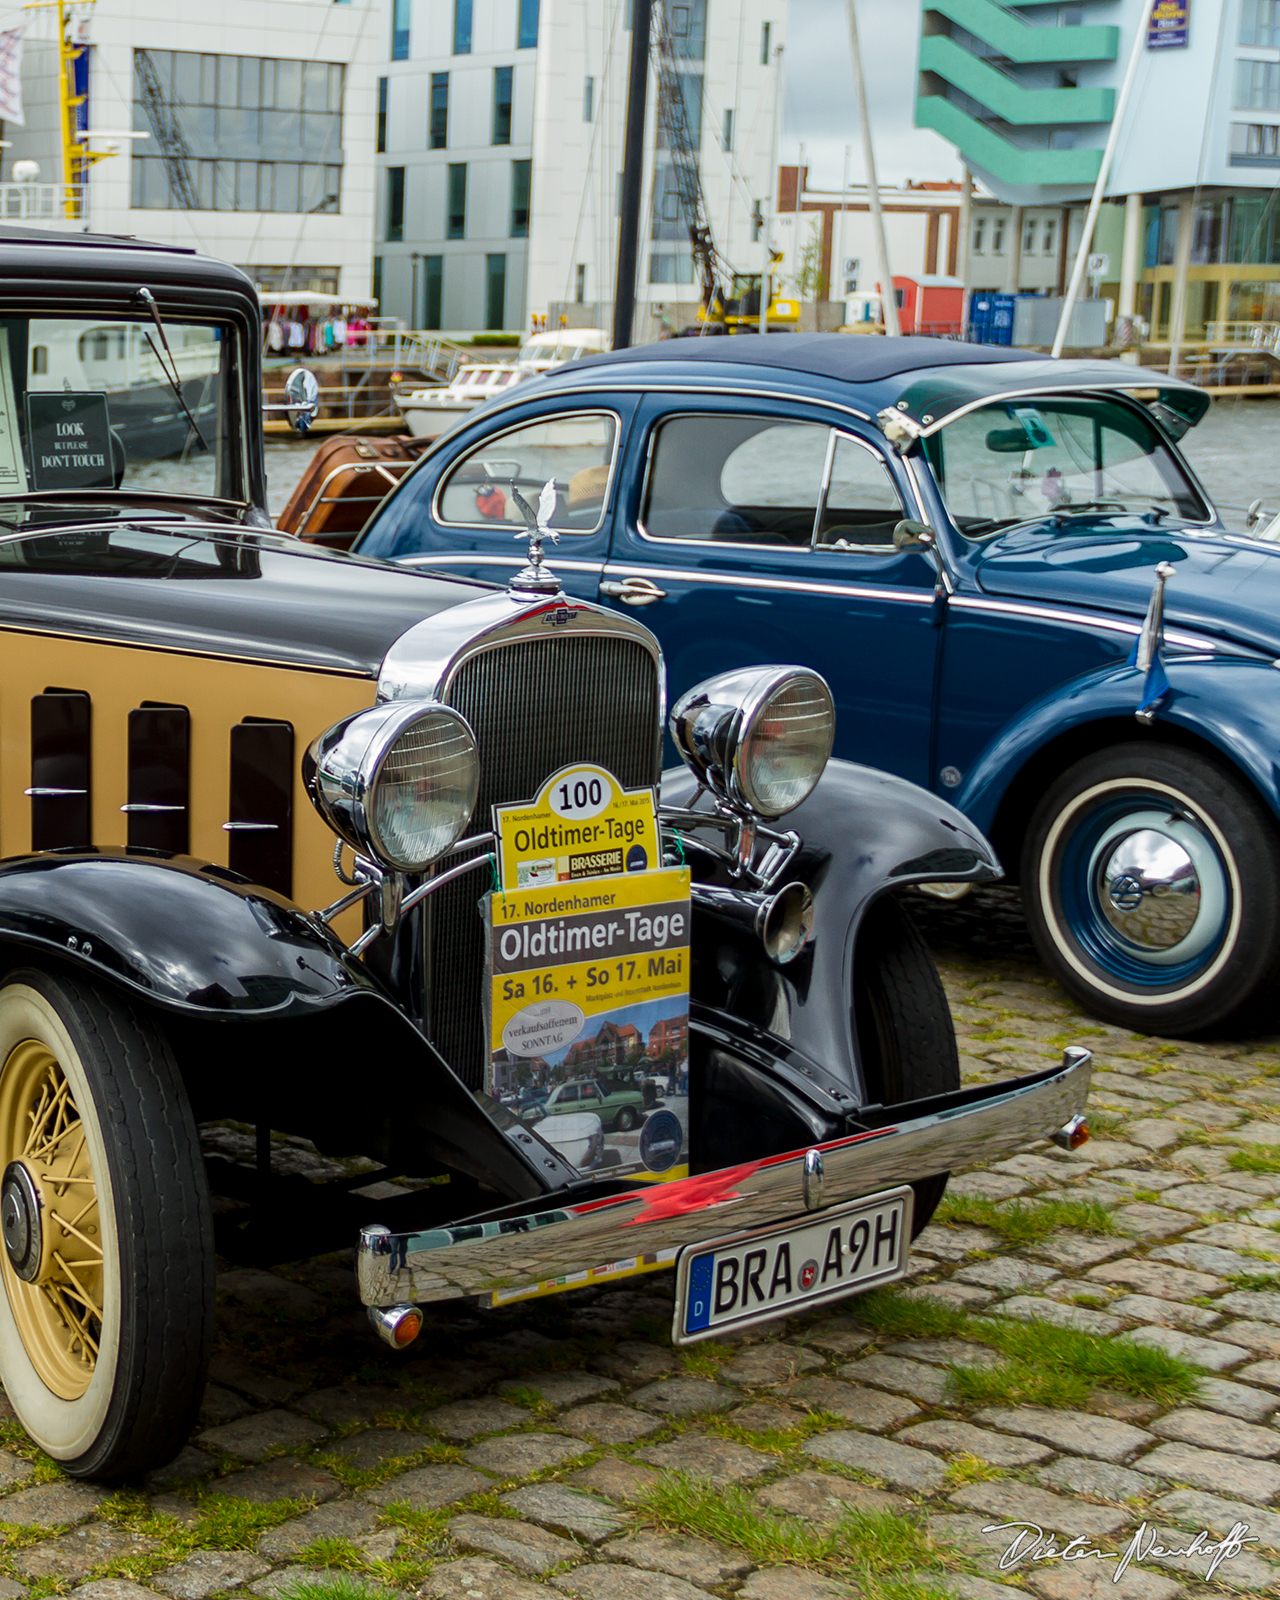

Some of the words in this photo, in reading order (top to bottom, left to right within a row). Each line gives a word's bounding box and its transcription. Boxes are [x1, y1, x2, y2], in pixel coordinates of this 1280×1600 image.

[56, 422, 85, 436] LOOK
[66, 442, 88, 450] PLEASE
[42, 455, 70, 468] DON'T
[72, 454, 104, 467] TOUCH
[560, 779, 602, 810] 100
[512, 812, 551, 822] Nordenhamer
[514, 818, 644, 852] Oldtimer-Tage
[571, 851, 621, 870] BRASSERIE
[501, 904, 520, 919] 17.
[525, 893, 616, 916] Nordenhamer
[500, 912, 684, 962] Oldtimer-Tage
[502, 980, 524, 1000] Sa
[532, 974, 558, 996] 16.
[567, 976, 577, 988] +
[586, 967, 610, 988] So
[616, 962, 641, 982] 17.
[648, 954, 682, 978] Mai
[508, 1016, 577, 1037] verkaufsoffenem
[522, 1032, 563, 1050] SONNTAG
[714, 1241, 792, 1314] BRA
[821, 1208, 898, 1284] A9H
[694, 1300, 704, 1317] D
